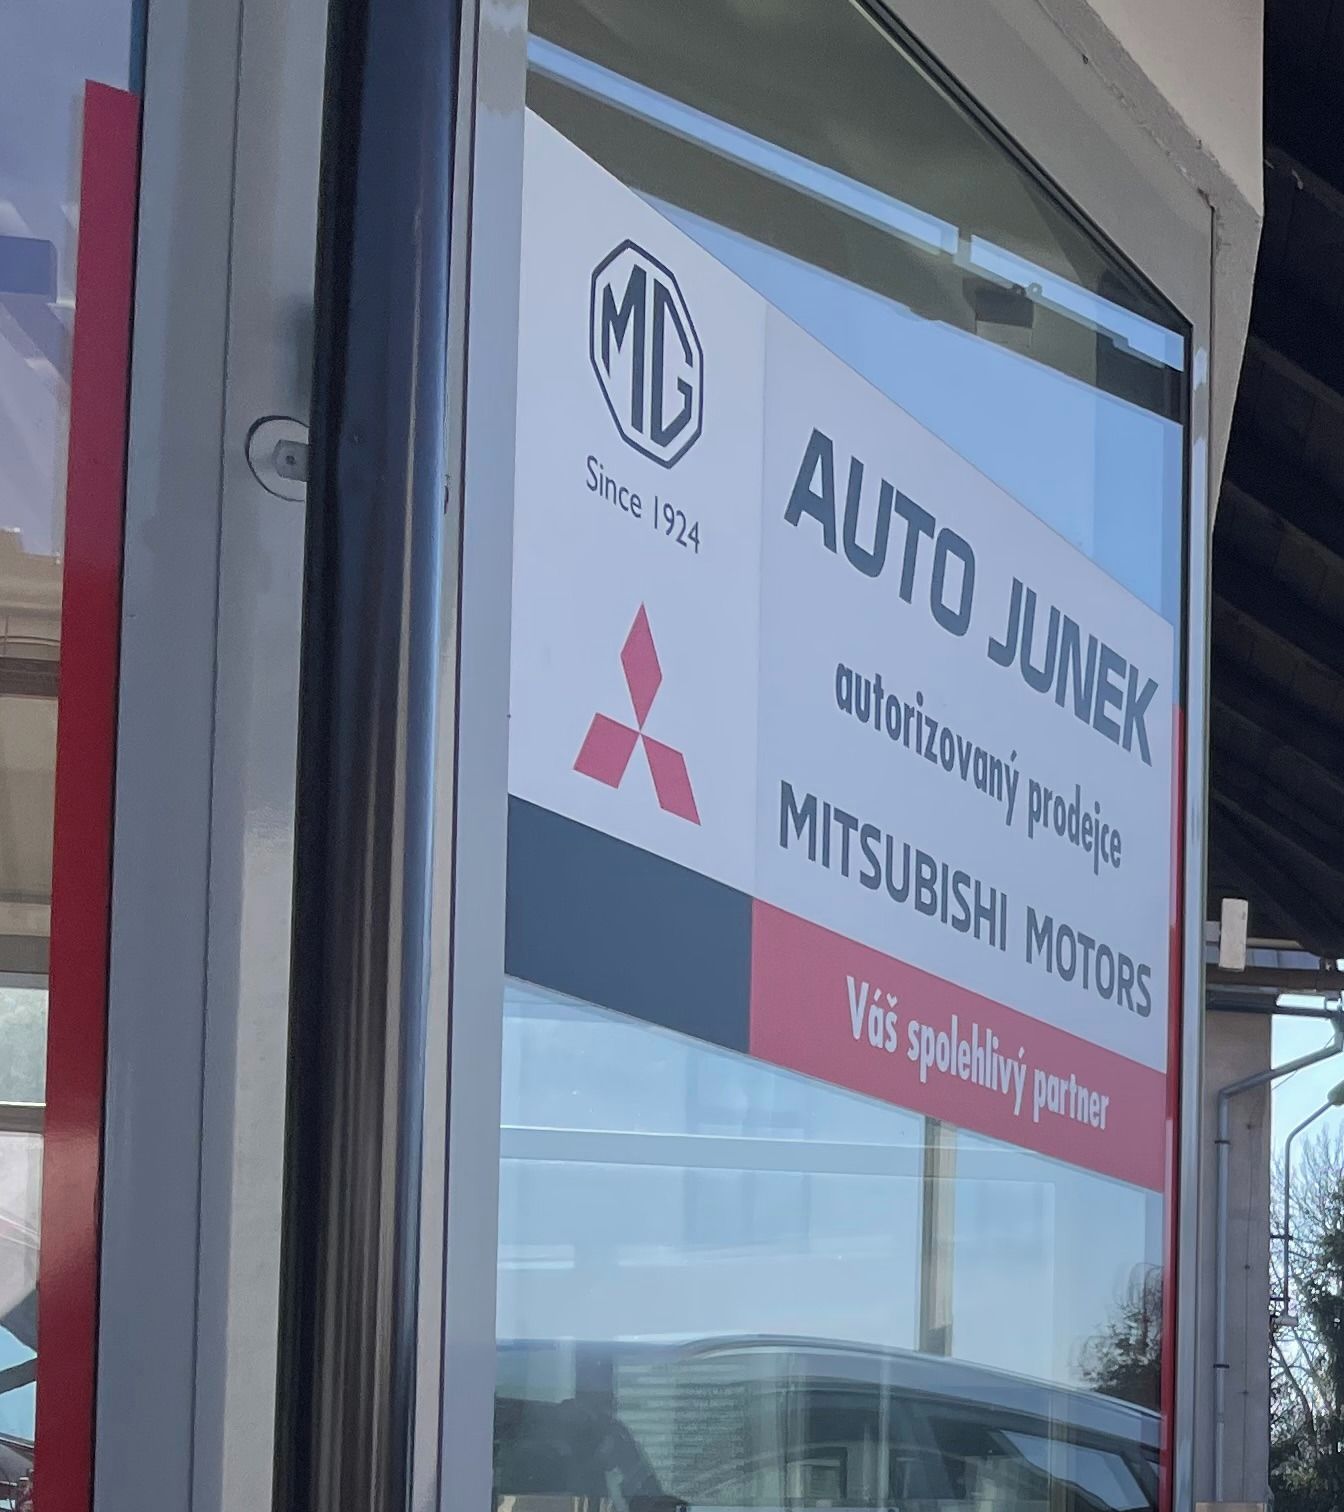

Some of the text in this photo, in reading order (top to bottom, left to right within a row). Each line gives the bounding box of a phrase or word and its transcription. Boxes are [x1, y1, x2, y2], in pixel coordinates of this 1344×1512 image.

[601, 263, 694, 448] MG
[586, 455, 701, 554] Since 1924
[783, 427, 1159, 768] AUTO JUNEK
[835, 662, 1122, 875] autorizovaný prodejce
[779, 779, 1152, 1018] MITSUBISHI MOTORS
[845, 975, 1109, 1130] Váš spolehlivý partner
